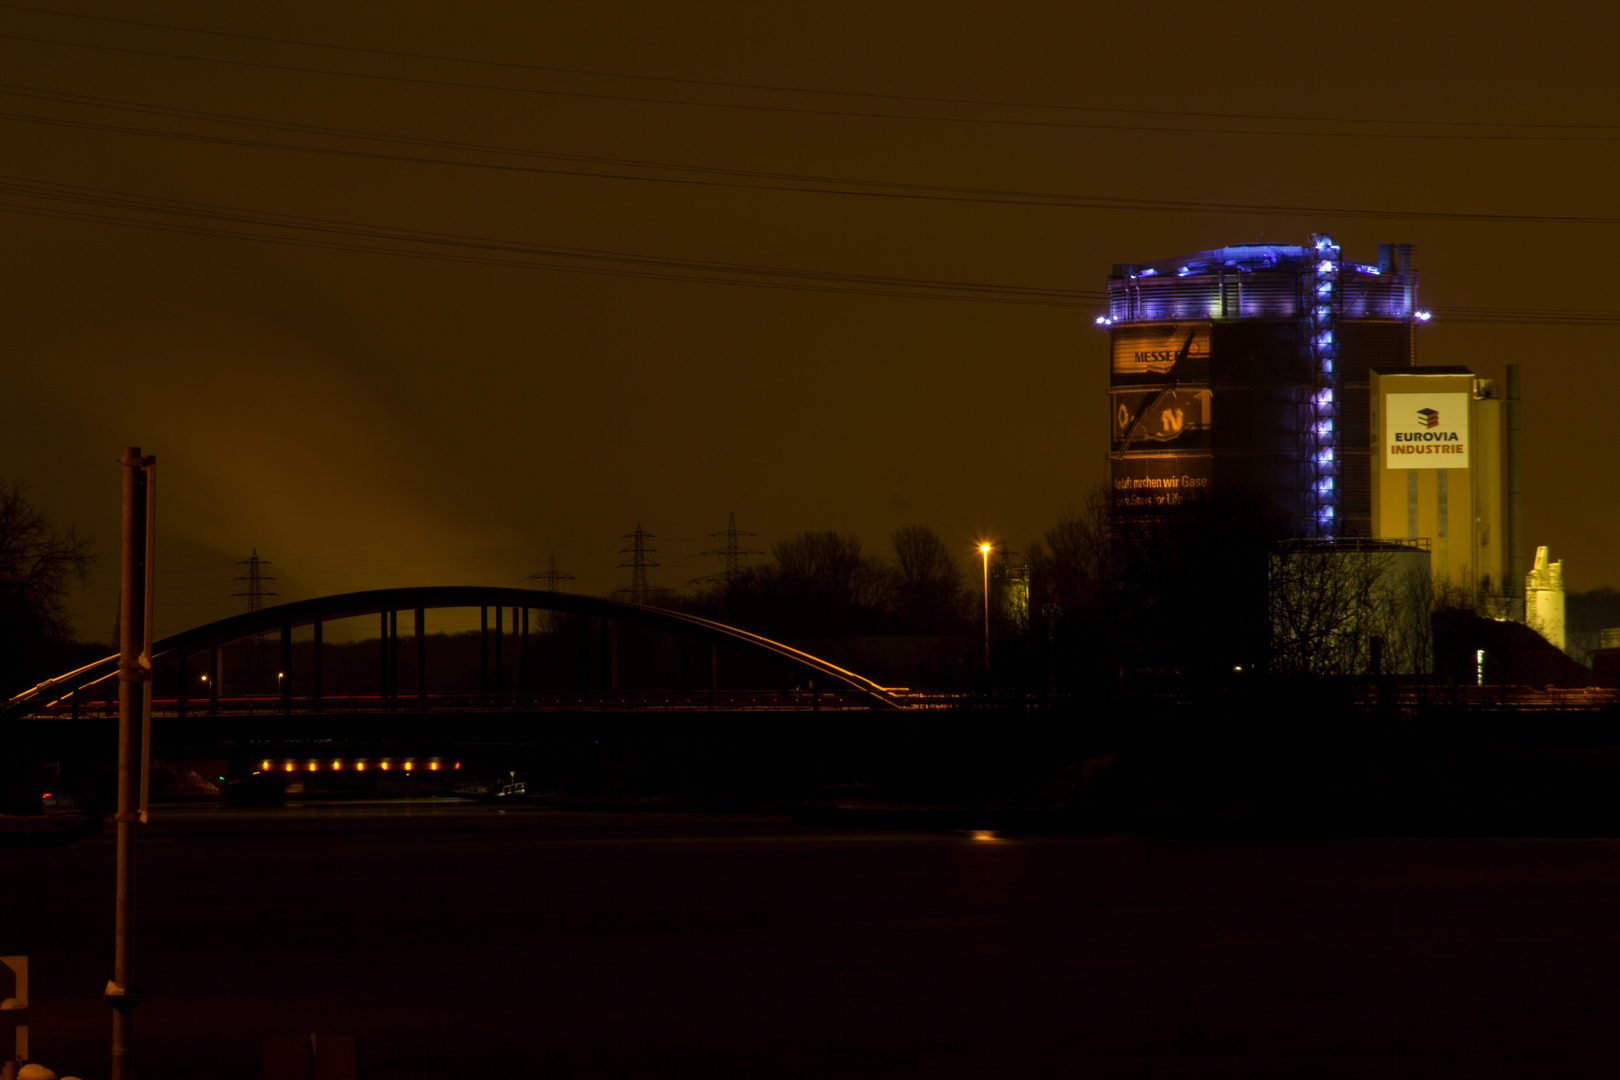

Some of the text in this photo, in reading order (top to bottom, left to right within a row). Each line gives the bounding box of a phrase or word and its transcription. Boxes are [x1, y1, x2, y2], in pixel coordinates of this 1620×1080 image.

[1395, 432, 1459, 442] EUROVIA
[1390, 444, 1464, 454] INDUSTRIE
[1162, 475, 1180, 488] wir
[1181, 475, 1208, 488] Gase
